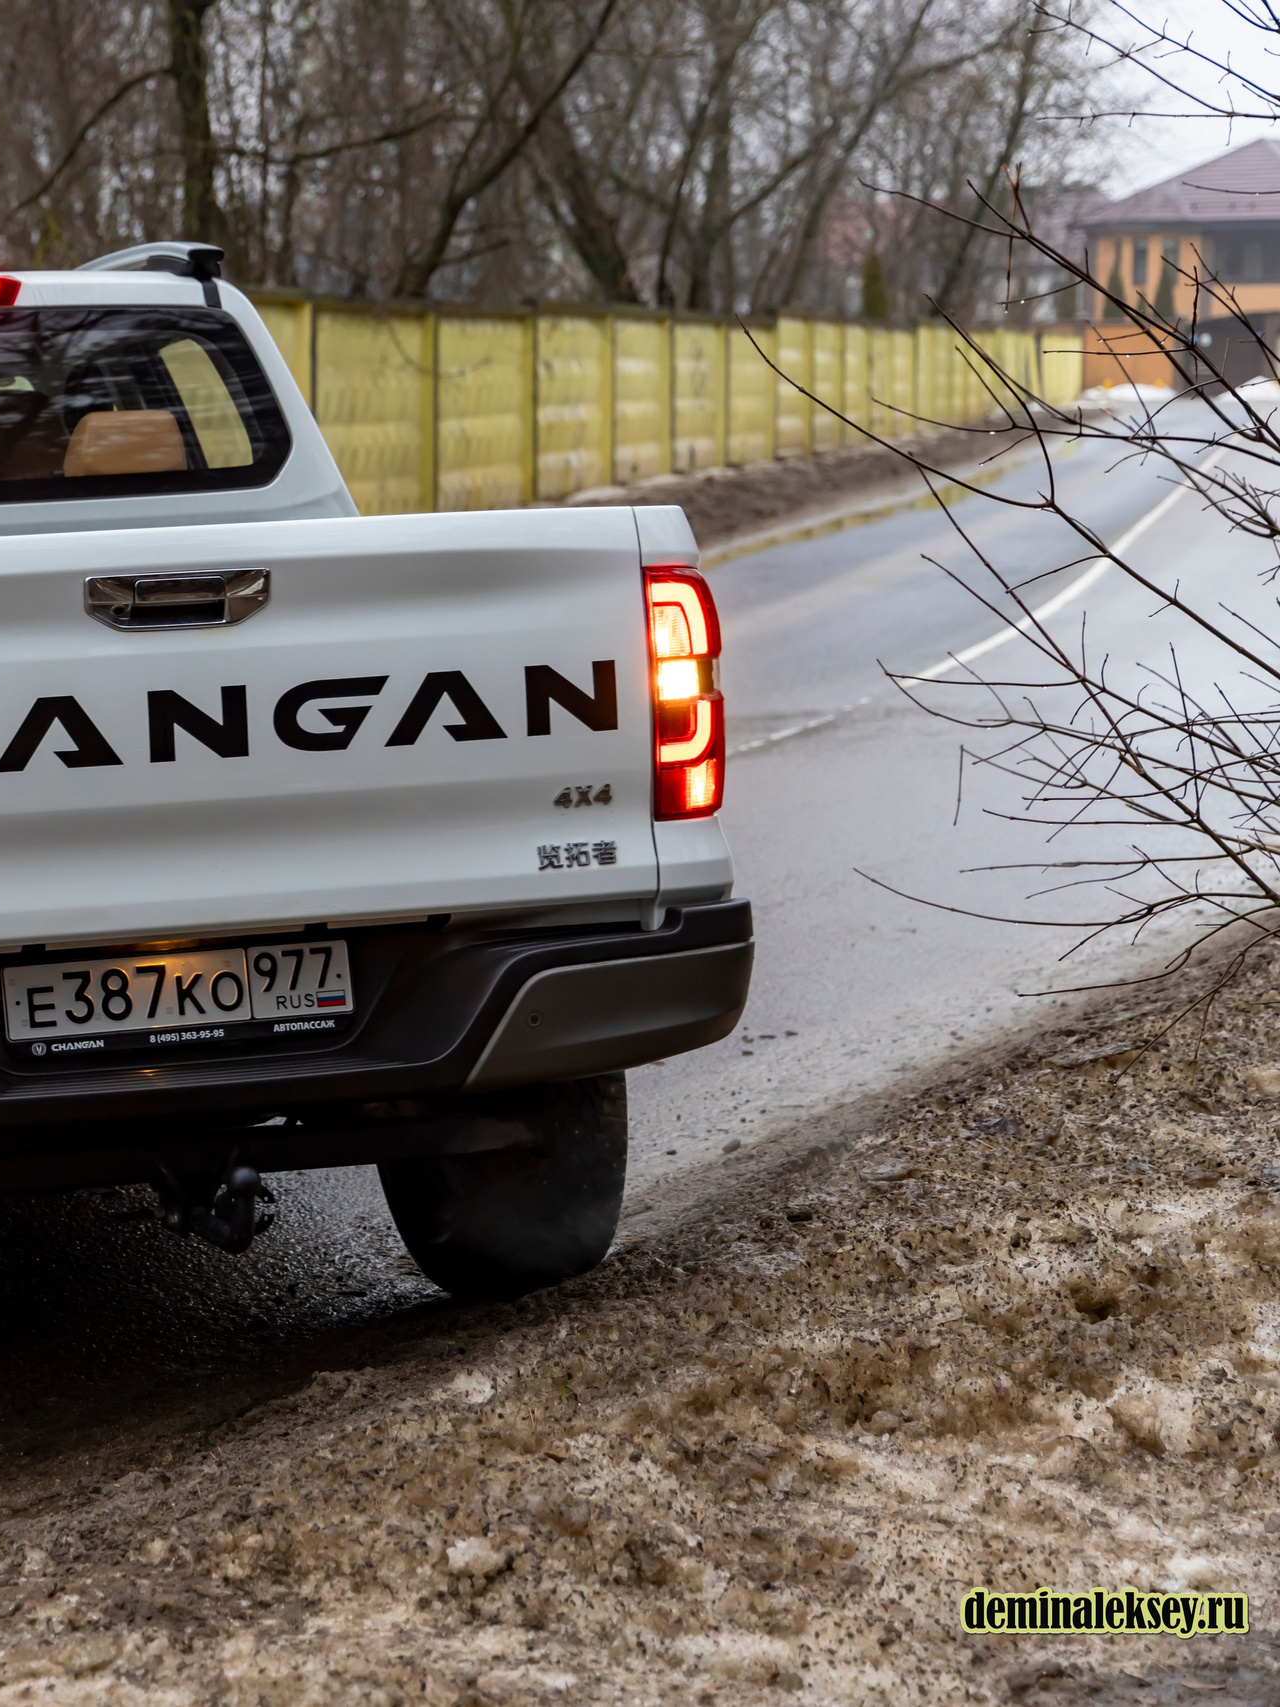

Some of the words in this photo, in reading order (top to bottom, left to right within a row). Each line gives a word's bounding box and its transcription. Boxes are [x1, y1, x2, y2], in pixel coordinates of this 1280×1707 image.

[537, 840, 617, 871] 览拓者
[252, 947, 332, 992] 977
[276, 993, 315, 1011] RUS
[273, 1019, 336, 1033] АВТОПАССАЖ
[149, 1034, 156, 1043] 8
[158, 1031, 180, 1044] (495)
[181, 1029, 225, 1042] 363-95-95
[51, 1040, 105, 1052] CHANGAN
